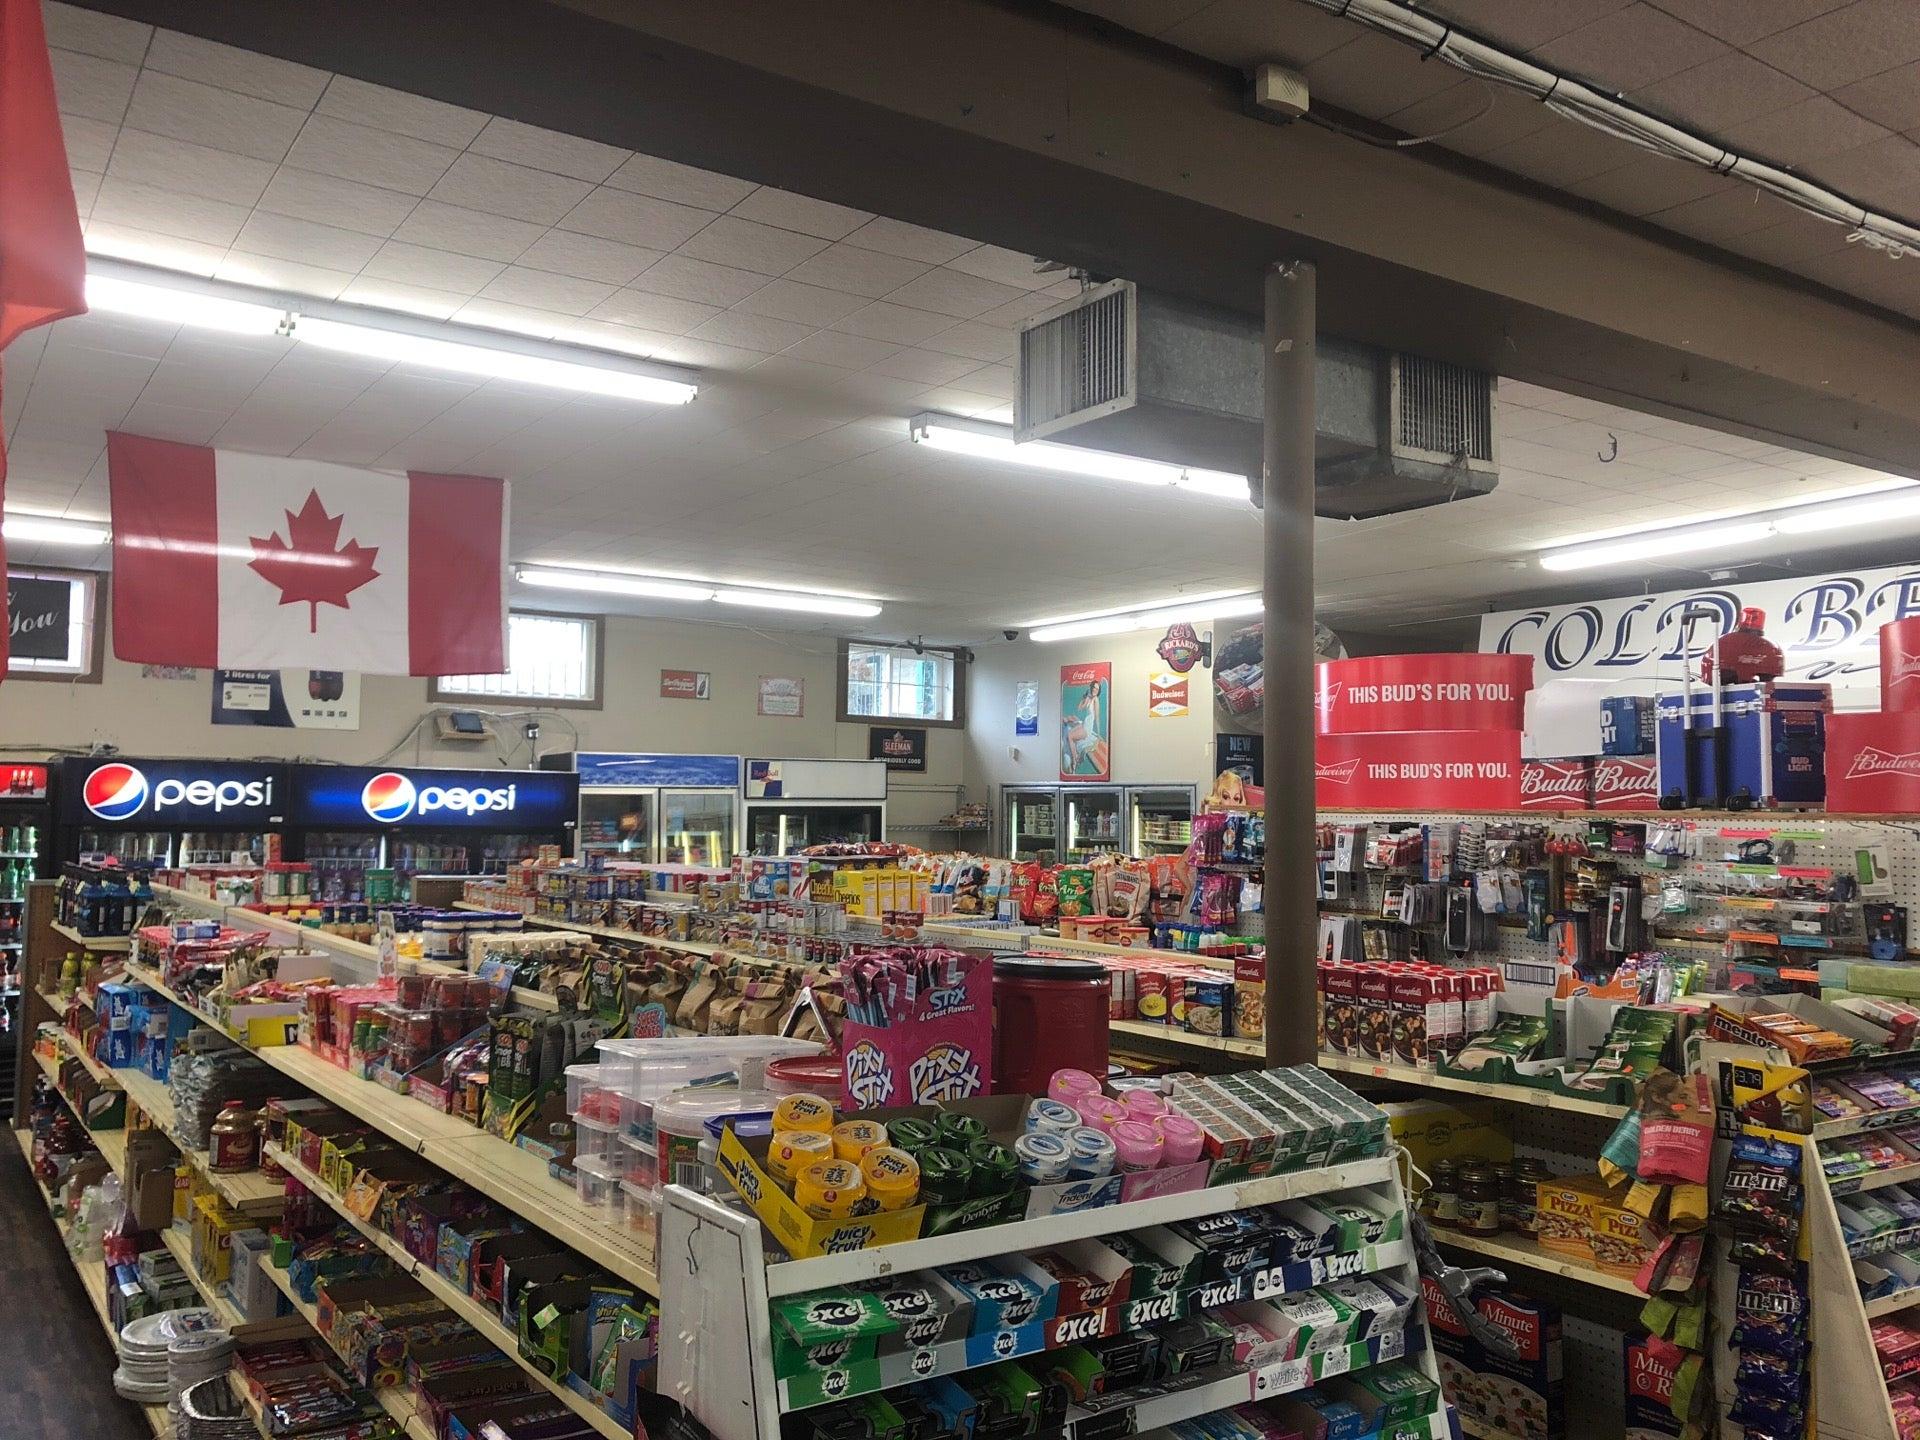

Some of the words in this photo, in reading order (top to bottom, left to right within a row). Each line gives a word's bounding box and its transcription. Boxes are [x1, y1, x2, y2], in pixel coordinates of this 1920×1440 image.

[1496, 590, 1743, 672] COLD
[1164, 640, 1199, 652] RICKARD'S
[231, 670, 255, 679] litres
[257, 671, 271, 680] for
[1348, 687, 1379, 704] THIS
[1381, 683, 1433, 703] BUD'S
[1437, 683, 1471, 701] FOR
[1475, 683, 1514, 701] YOU.
[884, 740, 911, 752] SLEEMAN
[1229, 736, 1251, 751] NEW
[1367, 764, 1398, 779] THIS
[1400, 763, 1443, 779] BUD'S
[1445, 763, 1474, 779] FOR
[1477, 762, 1512, 779] YOU.
[1788, 764, 1813, 772] LIGHT
[1790, 756, 1810, 765] BUD
[154, 776, 273, 812] pepsi
[418, 784, 516, 816] pepsi
[834, 892, 861, 906] Cheerios
[1327, 976, 1353, 989] Campbell's
[1360, 980, 1387, 993] Campbell's
[1394, 985, 1422, 998] Campbell's
[918, 1012, 926, 1022] 4
[926, 1008, 947, 1021] Great
[947, 1003, 975, 1015] Flavors!
[1058, 1190, 1094, 1205] Trident
[962, 1201, 1002, 1225] Dentyne
[1198, 1210, 1241, 1232] excel
[1292, 1233, 1323, 1252] excel
[1222, 1246, 1255, 1268] excel
[1328, 1249, 1366, 1278] excel
[1153, 1264, 1188, 1288] excel
[883, 1288, 933, 1312] excel
[977, 1279, 1024, 1300] excel
[1079, 1280, 1117, 1302] excel
[1201, 1276, 1242, 1308] excel
[806, 1298, 866, 1323] excel
[1001, 1296, 1040, 1319] excel
[1129, 1291, 1178, 1326] excel
[1484, 1303, 1534, 1333] Minute
[904, 1313, 948, 1340] excel
[1055, 1306, 1107, 1343] excel
[807, 1337, 852, 1360] excel
[993, 1331, 1018, 1350] excel
[911, 1350, 937, 1370] excel
[822, 1369, 850, 1390] excel
[1269, 1366, 1300, 1388] White
[1378, 1376, 1422, 1393] Extra
